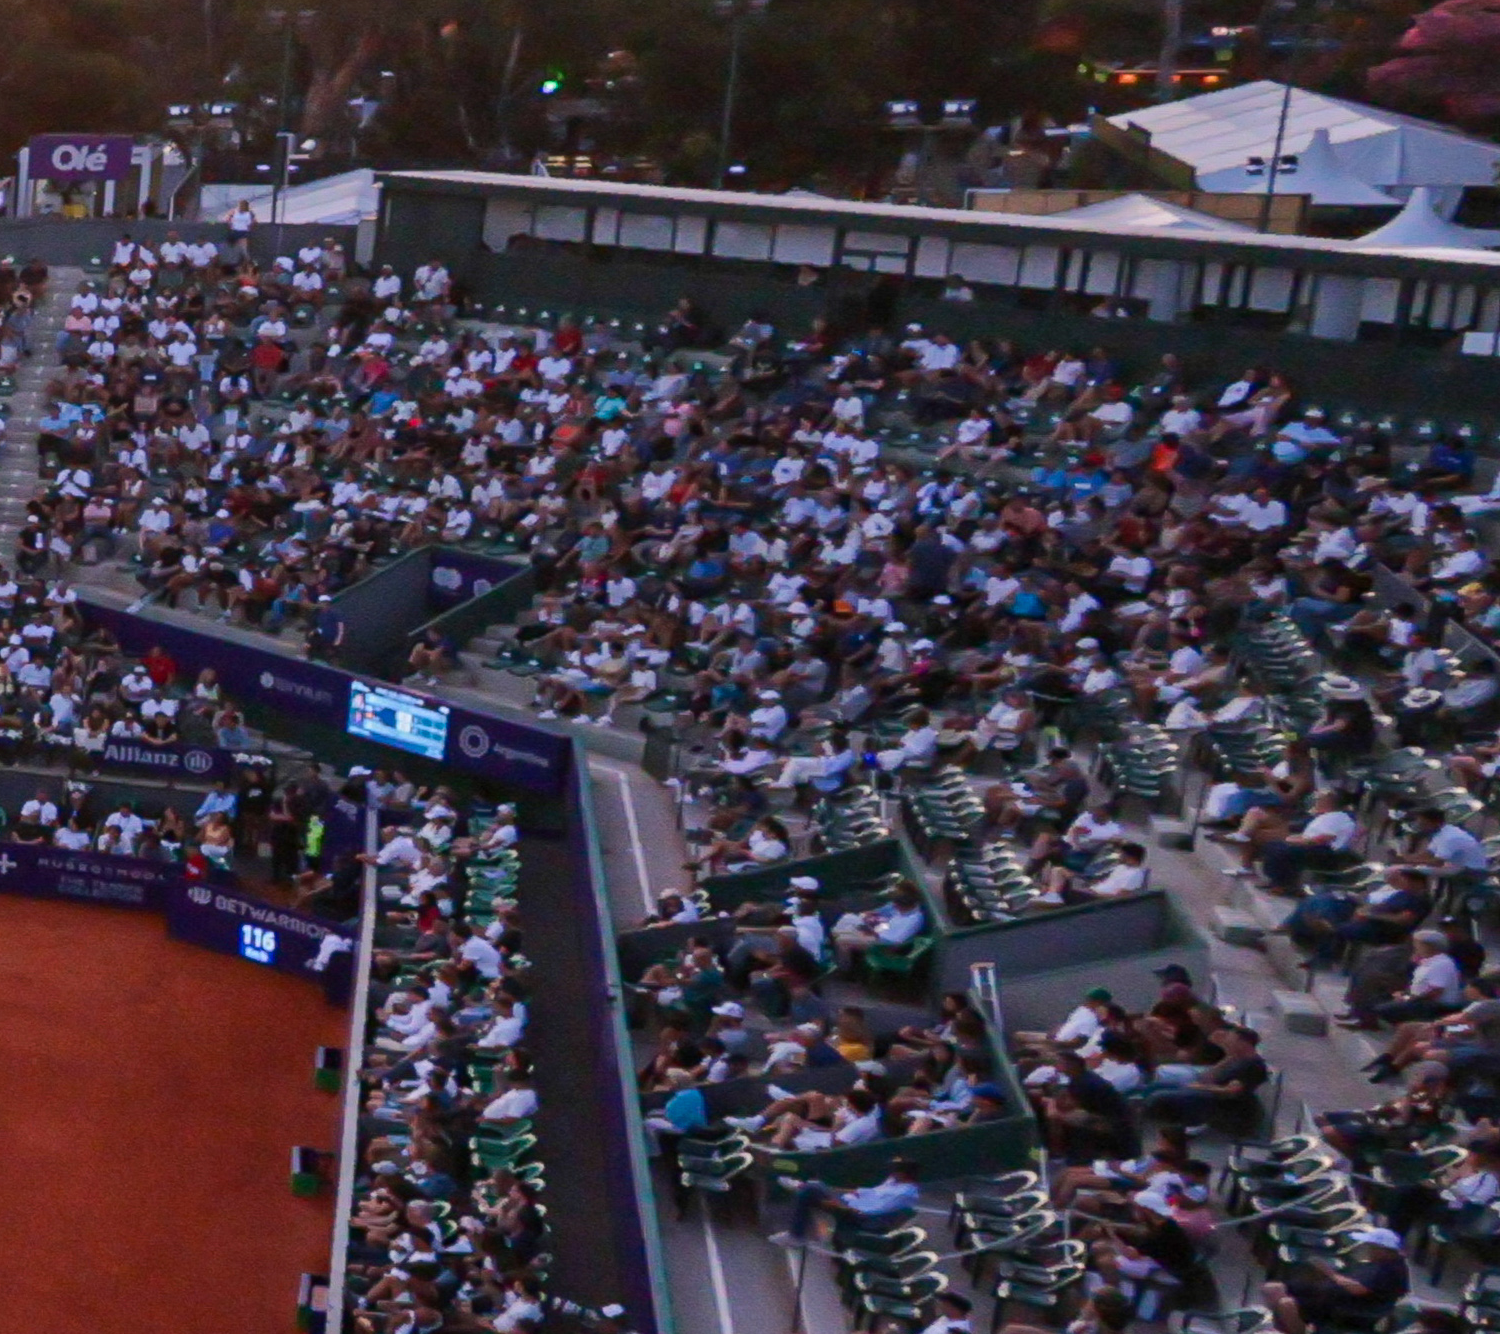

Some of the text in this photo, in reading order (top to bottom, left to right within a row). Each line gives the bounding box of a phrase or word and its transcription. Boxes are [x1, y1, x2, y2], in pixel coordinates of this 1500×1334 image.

[51, 143, 108, 172] Olé
[103, 739, 180, 767] Allianz
[241, 924, 276, 953] 116
